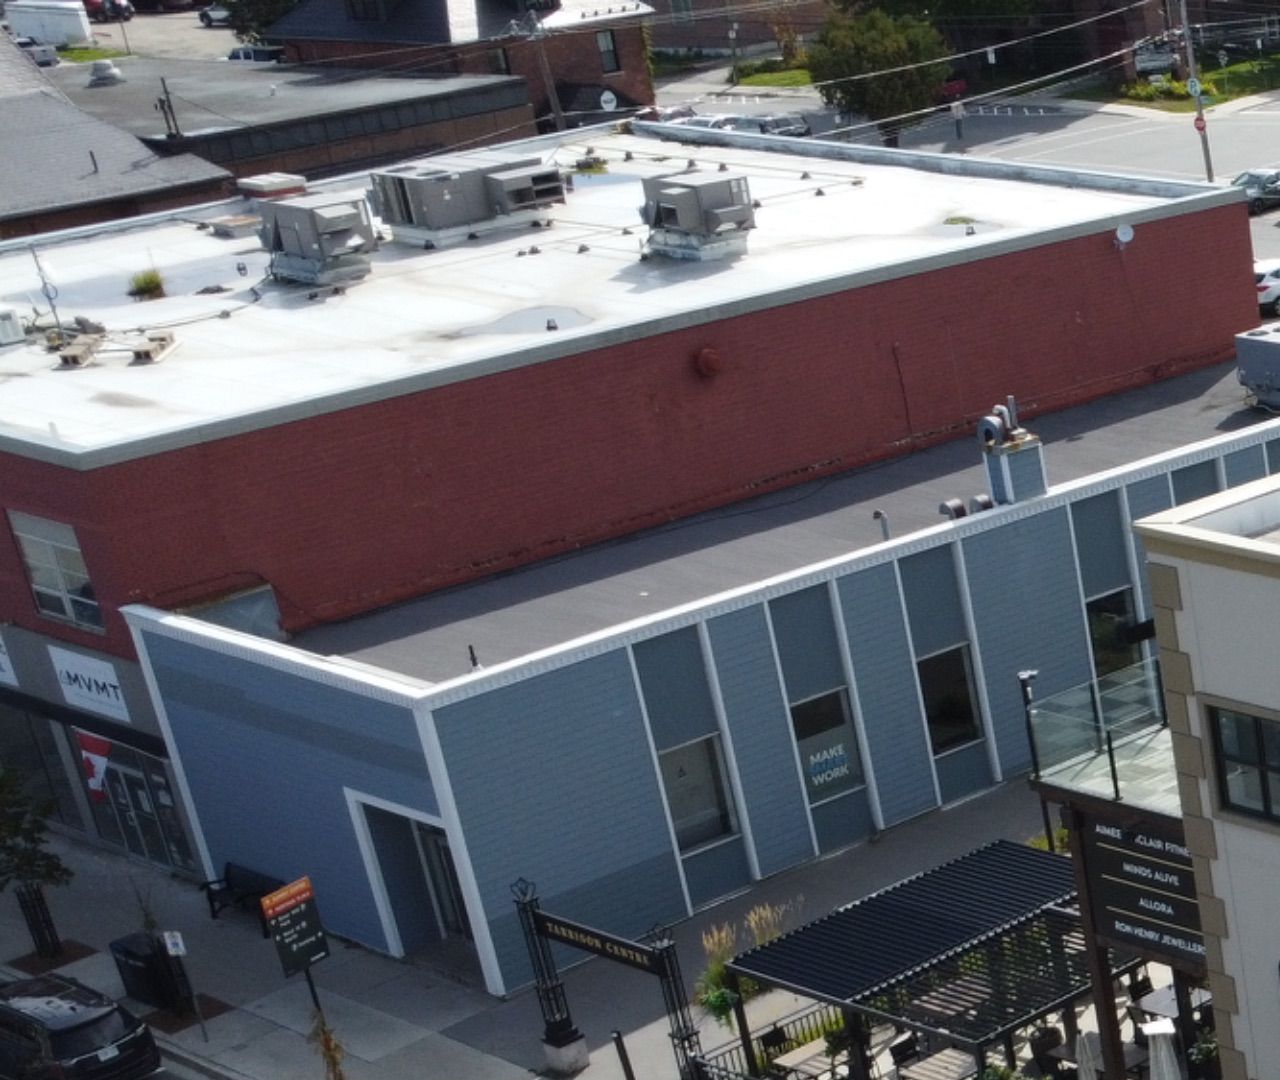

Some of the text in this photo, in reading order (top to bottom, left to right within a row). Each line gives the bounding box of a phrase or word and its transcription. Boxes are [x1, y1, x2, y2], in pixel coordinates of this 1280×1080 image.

[65, 670, 120, 702] MVMT
[809, 743, 846, 765] MAKE
[811, 765, 850, 787] WORK
[1095, 823, 1123, 840] AIMEE
[1122, 861, 1180, 887] MINDS ALIVE
[1138, 896, 1175, 916] ALLORA
[1114, 919, 1133, 935] RON
[1133, 926, 1161, 943] HENRY
[544, 920, 651, 968] TARRISON CENTRE
